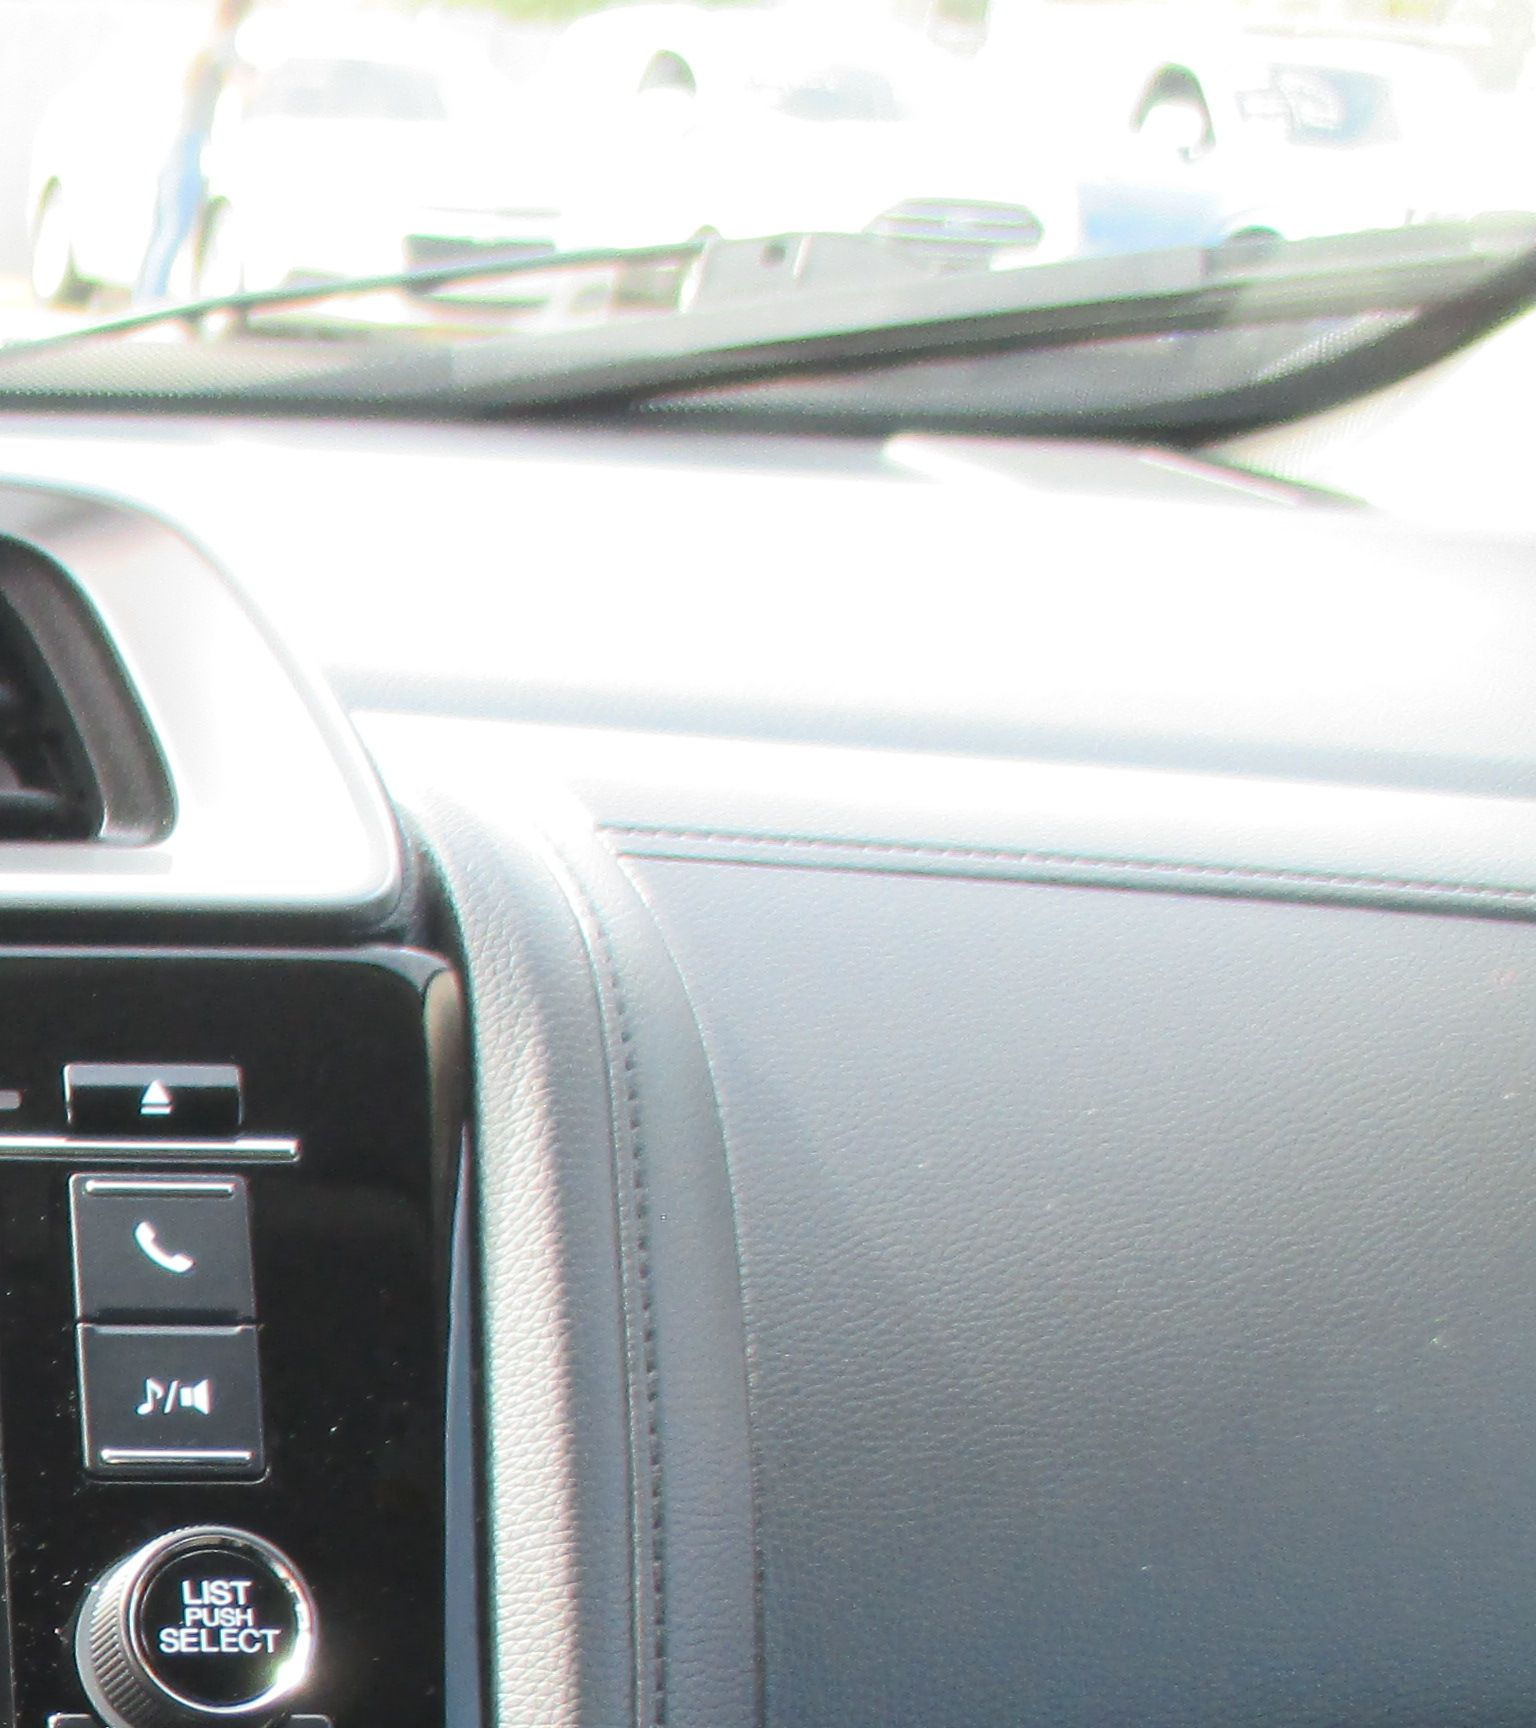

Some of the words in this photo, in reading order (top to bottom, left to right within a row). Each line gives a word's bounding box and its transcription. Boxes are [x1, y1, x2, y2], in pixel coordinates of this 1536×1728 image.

[181, 1580, 252, 1607] LIST
[185, 1608, 254, 1628] PUSH
[159, 1628, 281, 1654] SELECT
